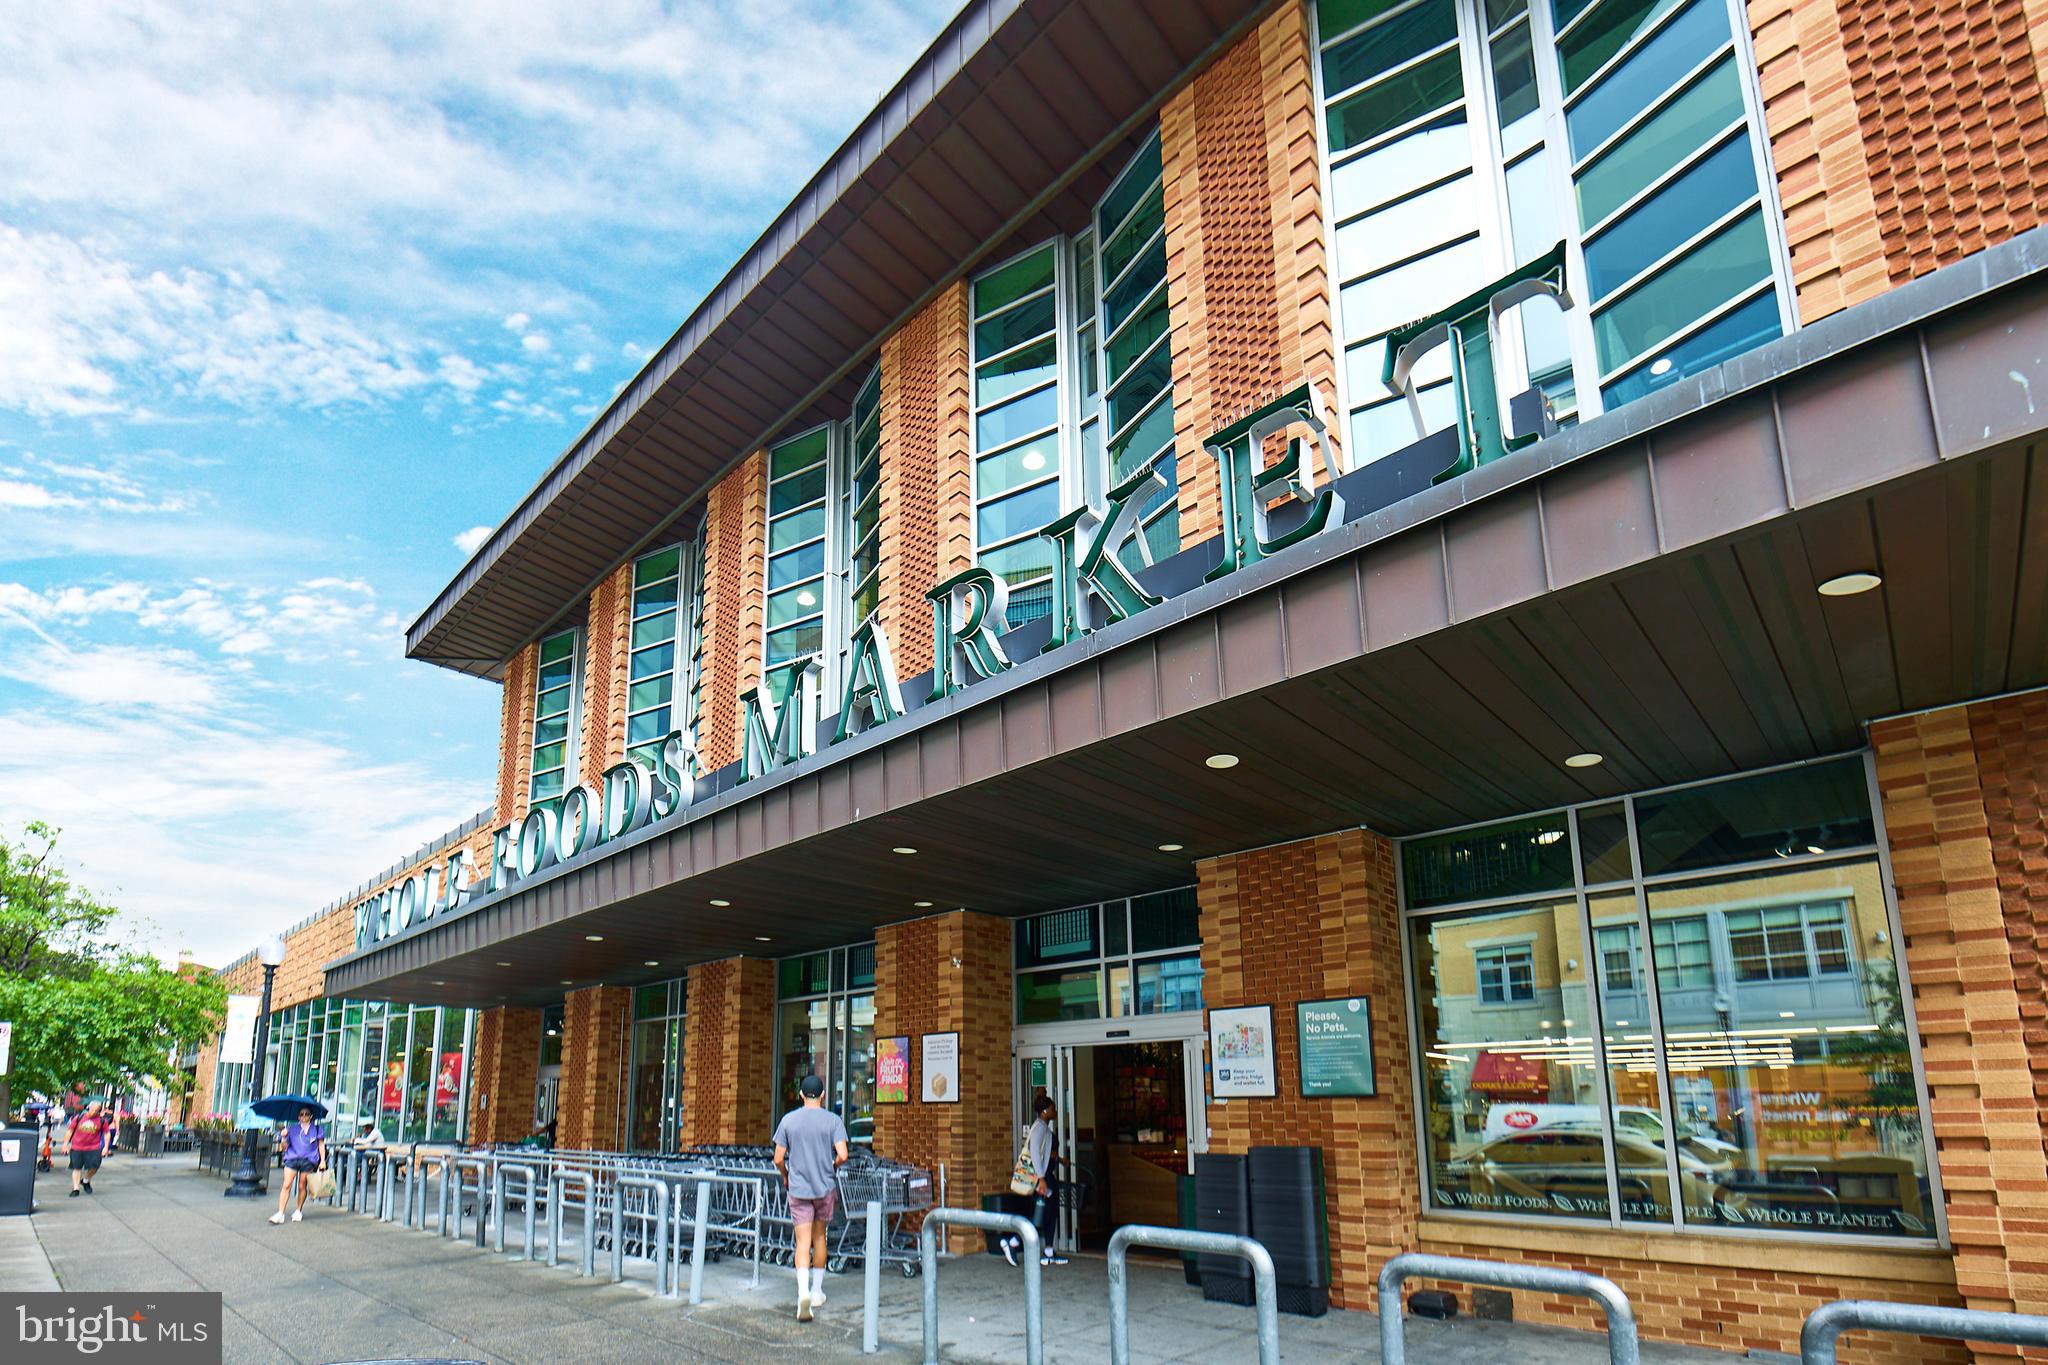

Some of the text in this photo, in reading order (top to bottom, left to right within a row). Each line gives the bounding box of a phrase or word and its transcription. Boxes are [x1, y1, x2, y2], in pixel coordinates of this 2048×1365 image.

[353, 239, 1573, 950] WHOLE FOODS MARKET
[1305, 1011, 1340, 1022] Please,
[1305, 1022, 1348, 1033] No Pets.
[1454, 1192, 1502, 1206] WHOLE
[1504, 1194, 1553, 1209] FOODS.
[1745, 1207, 1812, 1224] WHOLE
[1815, 1209, 1893, 1228] PLANET.
